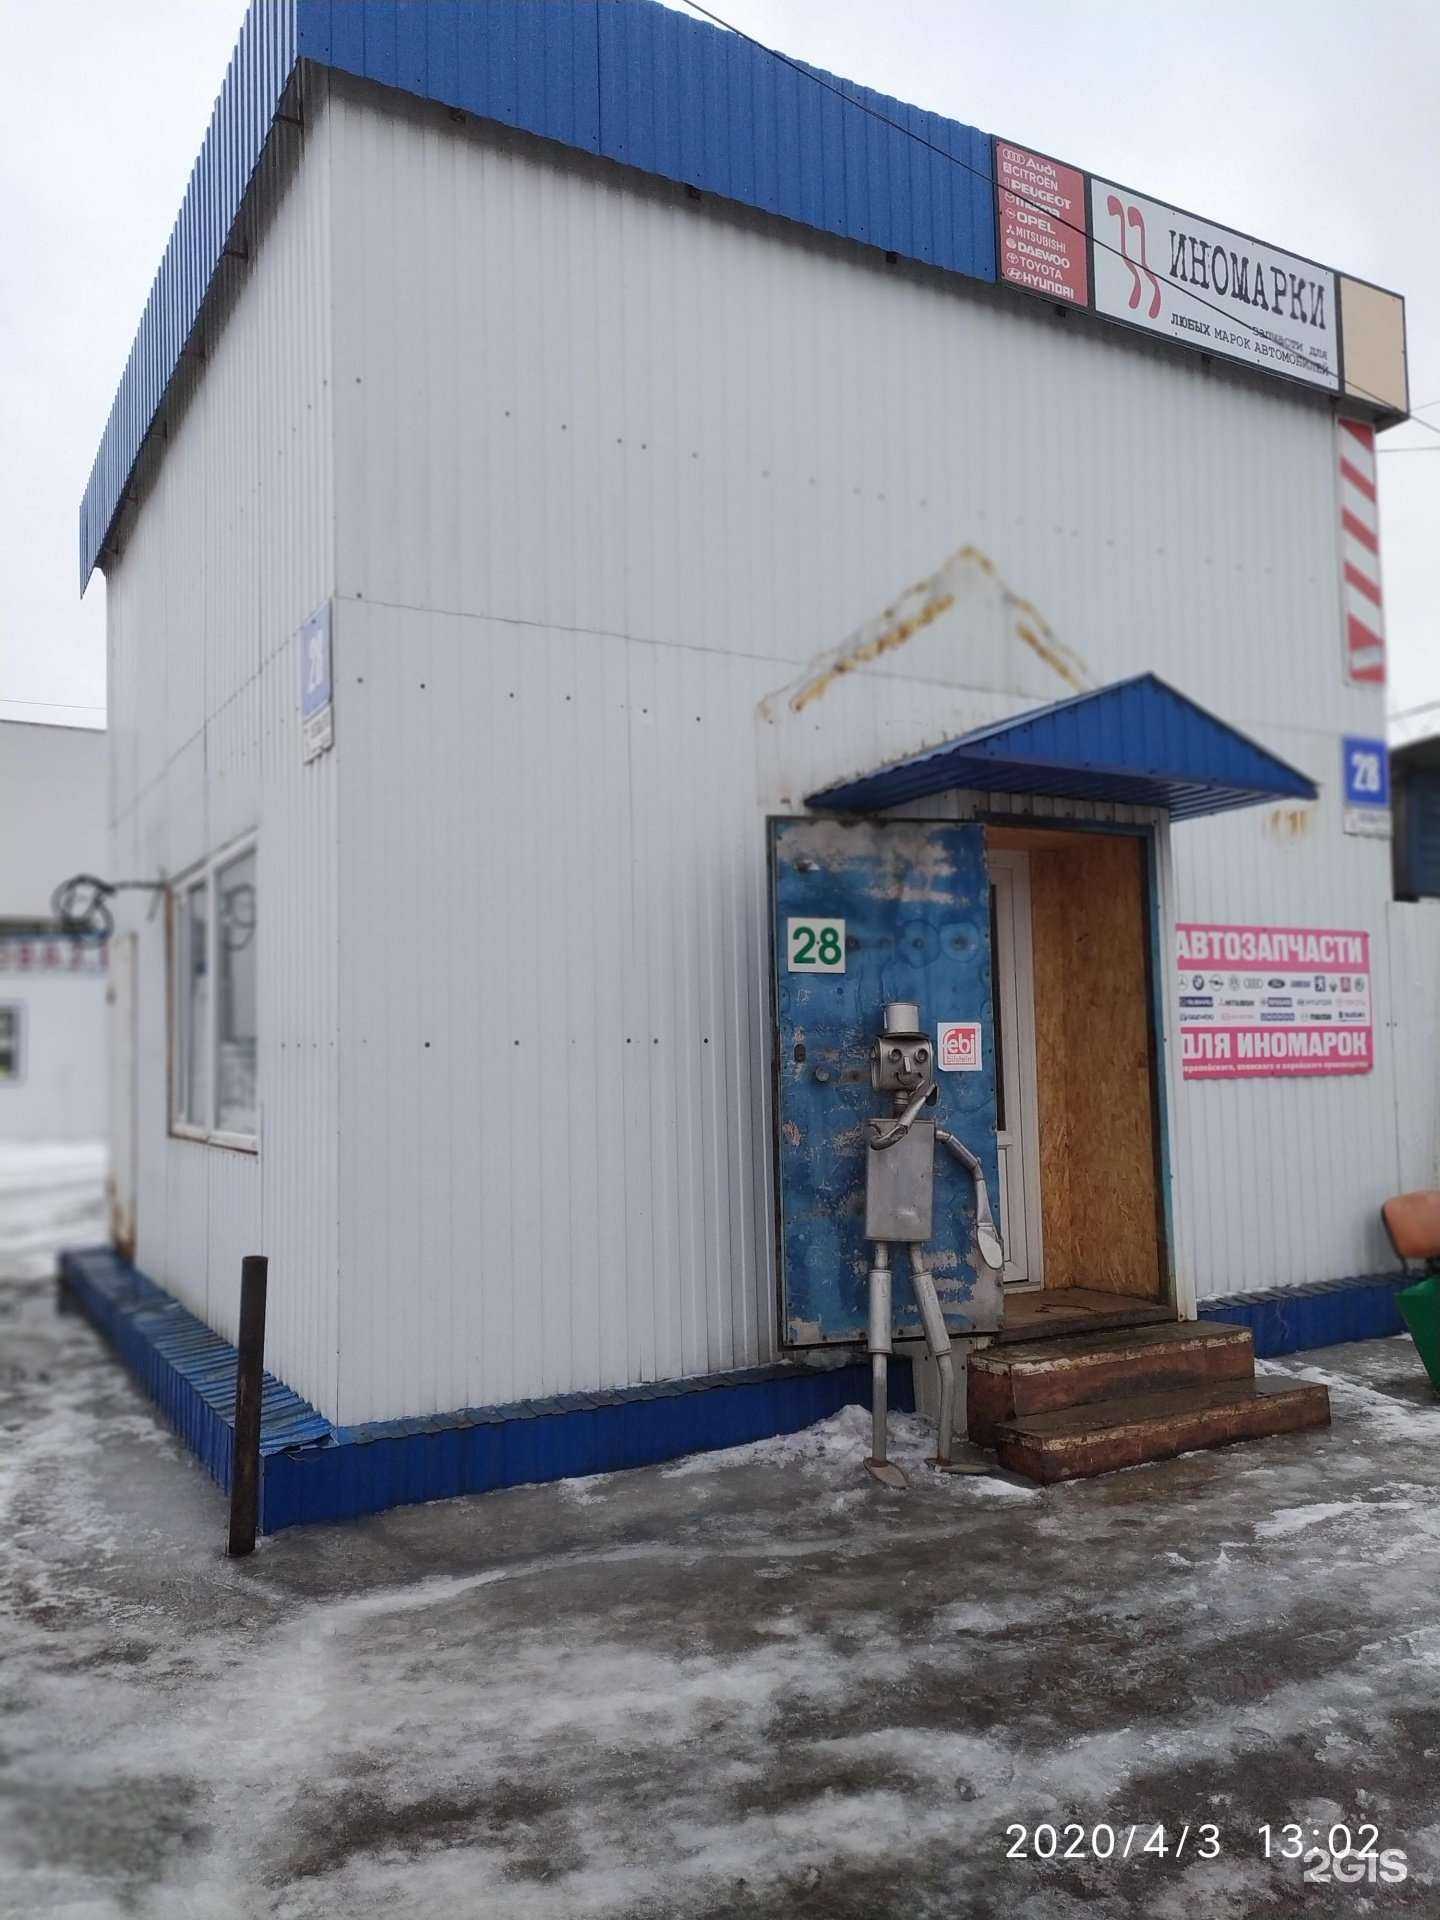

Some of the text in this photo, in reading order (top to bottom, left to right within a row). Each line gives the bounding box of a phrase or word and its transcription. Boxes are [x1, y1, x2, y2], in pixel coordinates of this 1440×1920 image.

[1026, 158, 1056, 177] Audi
[1011, 179, 1072, 210] PEUGEOT
[1017, 212, 1056, 235] OPEL
[1016, 226, 1066, 253] MITSUBISHI
[1018, 242, 1070, 268] DAEWOO
[1020, 256, 1063, 280] TOYOTA
[1168, 230, 1327, 330] ИНОМАРКИ
[1170, 312, 1211, 337] ЛЮБЫХ
[1214, 329, 1251, 351] МАРОК
[1352, 752, 1380, 792] 28
[793, 926, 842, 965] 28
[1176, 930, 1363, 964] АВТОЗАПЧАСТИ
[1237, 1032, 1368, 1058] ИНОМАРОК
